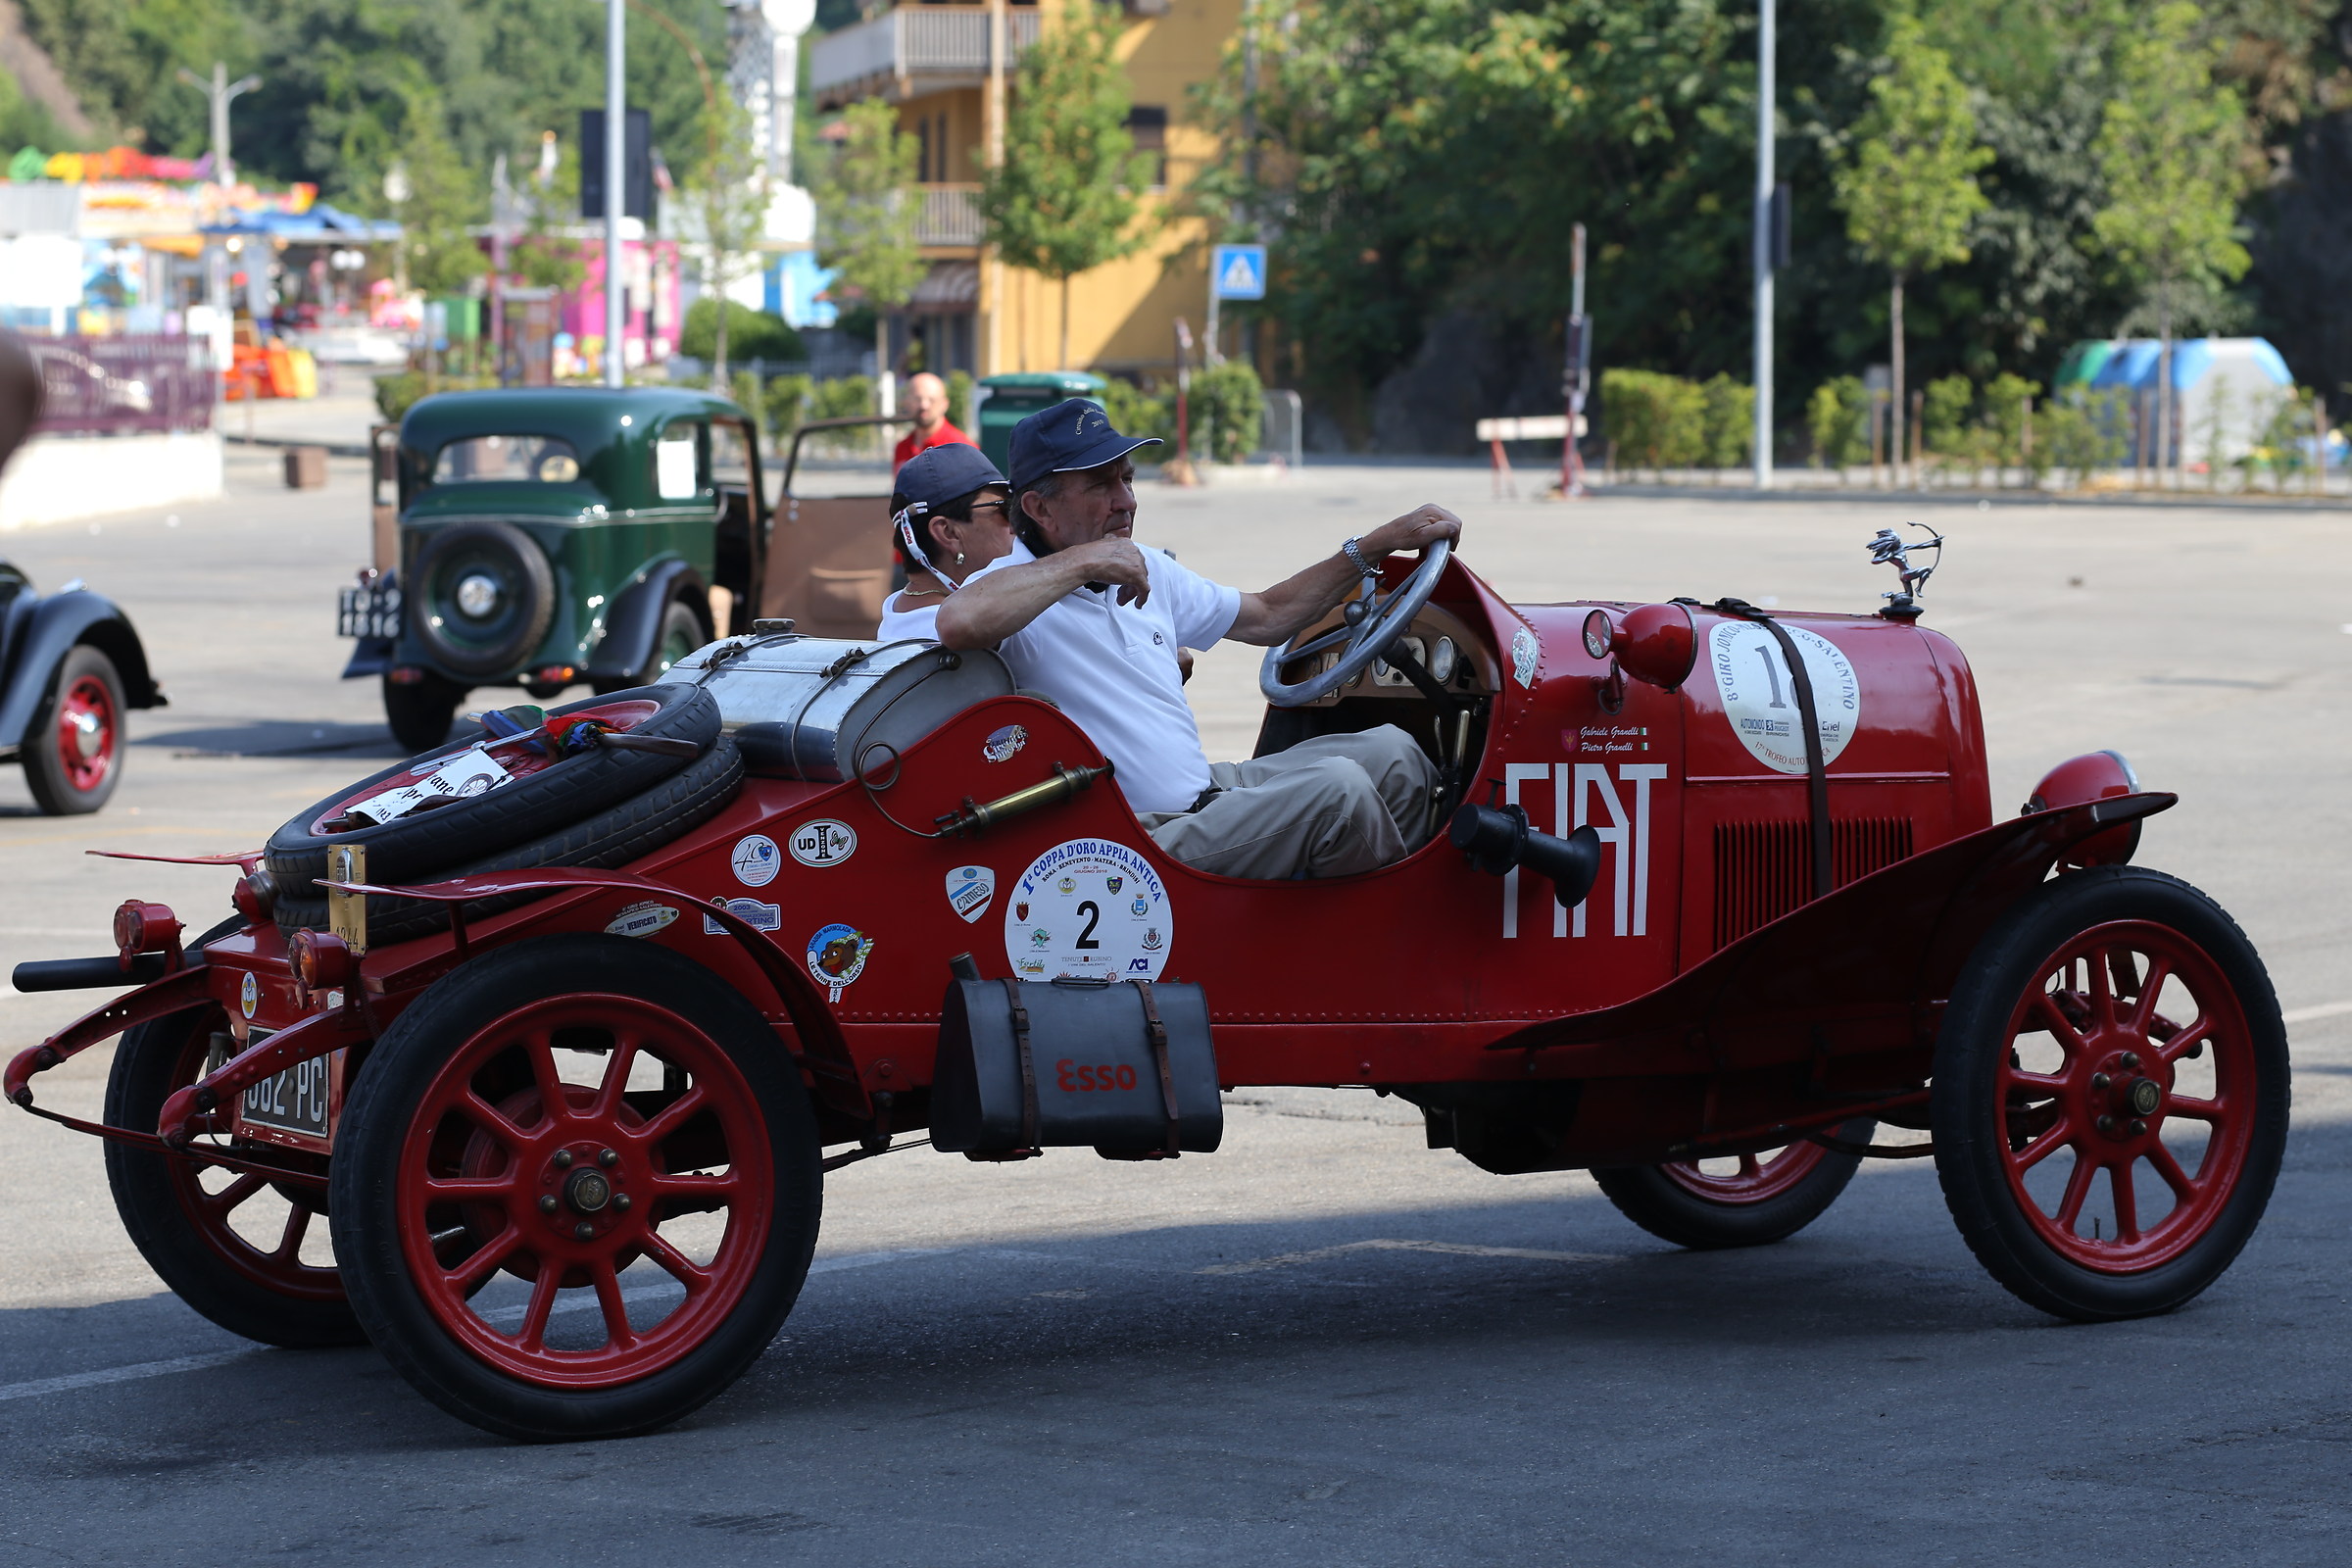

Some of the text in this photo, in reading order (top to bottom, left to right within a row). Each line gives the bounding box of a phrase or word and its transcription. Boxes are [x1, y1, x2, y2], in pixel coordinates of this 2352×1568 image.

[1580, 725, 1639, 739] Gabriele Granelli
[1581, 741, 1634, 755] Pietro Granelli
[1764, 748, 1788, 764] TROFEO
[798, 837, 816, 851] UD
[1502, 762, 1668, 939] FIAT
[1033, 848, 1065, 876] COPPA
[1066, 842, 1097, 858] D'ORO
[1098, 843, 1129, 863] APPIA
[1129, 856, 1162, 903] ANTICA
[1042, 857, 1141, 884] ROMA BENEVENTO MATERA BRINDISI
[626, 915, 658, 931] VERIFICATO
[822, 924, 852, 933] MARMOLADA
[1075, 900, 1100, 950] 2
[808, 960, 816, 970] LE
[832, 963, 862, 987] DELL'ORSO
[1128, 957, 1149, 971] ACI
[1055, 1058, 1137, 1093] Esso
[296, 1056, 323, 1123] PC
